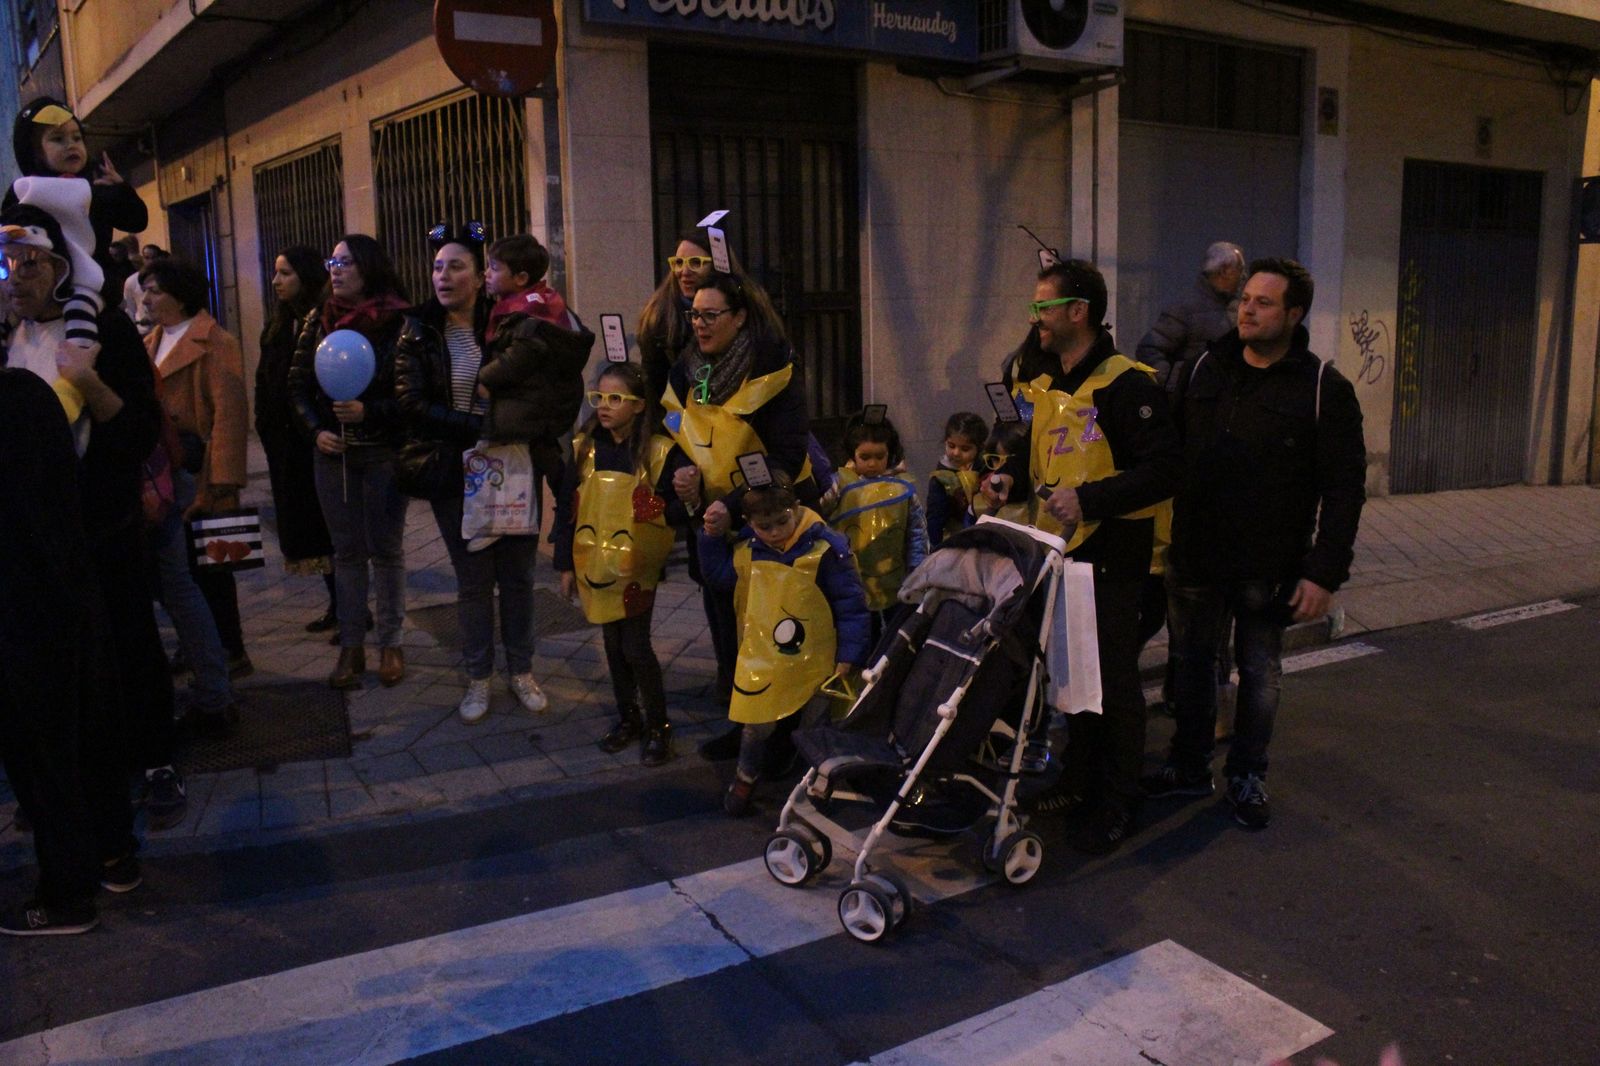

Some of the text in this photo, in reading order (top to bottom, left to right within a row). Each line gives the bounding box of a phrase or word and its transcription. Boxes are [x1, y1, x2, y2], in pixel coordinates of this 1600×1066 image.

[611, 0, 835, 31] scaos
[873, 2, 958, 43] Hernandez
[1048, 427, 1073, 455] Z
